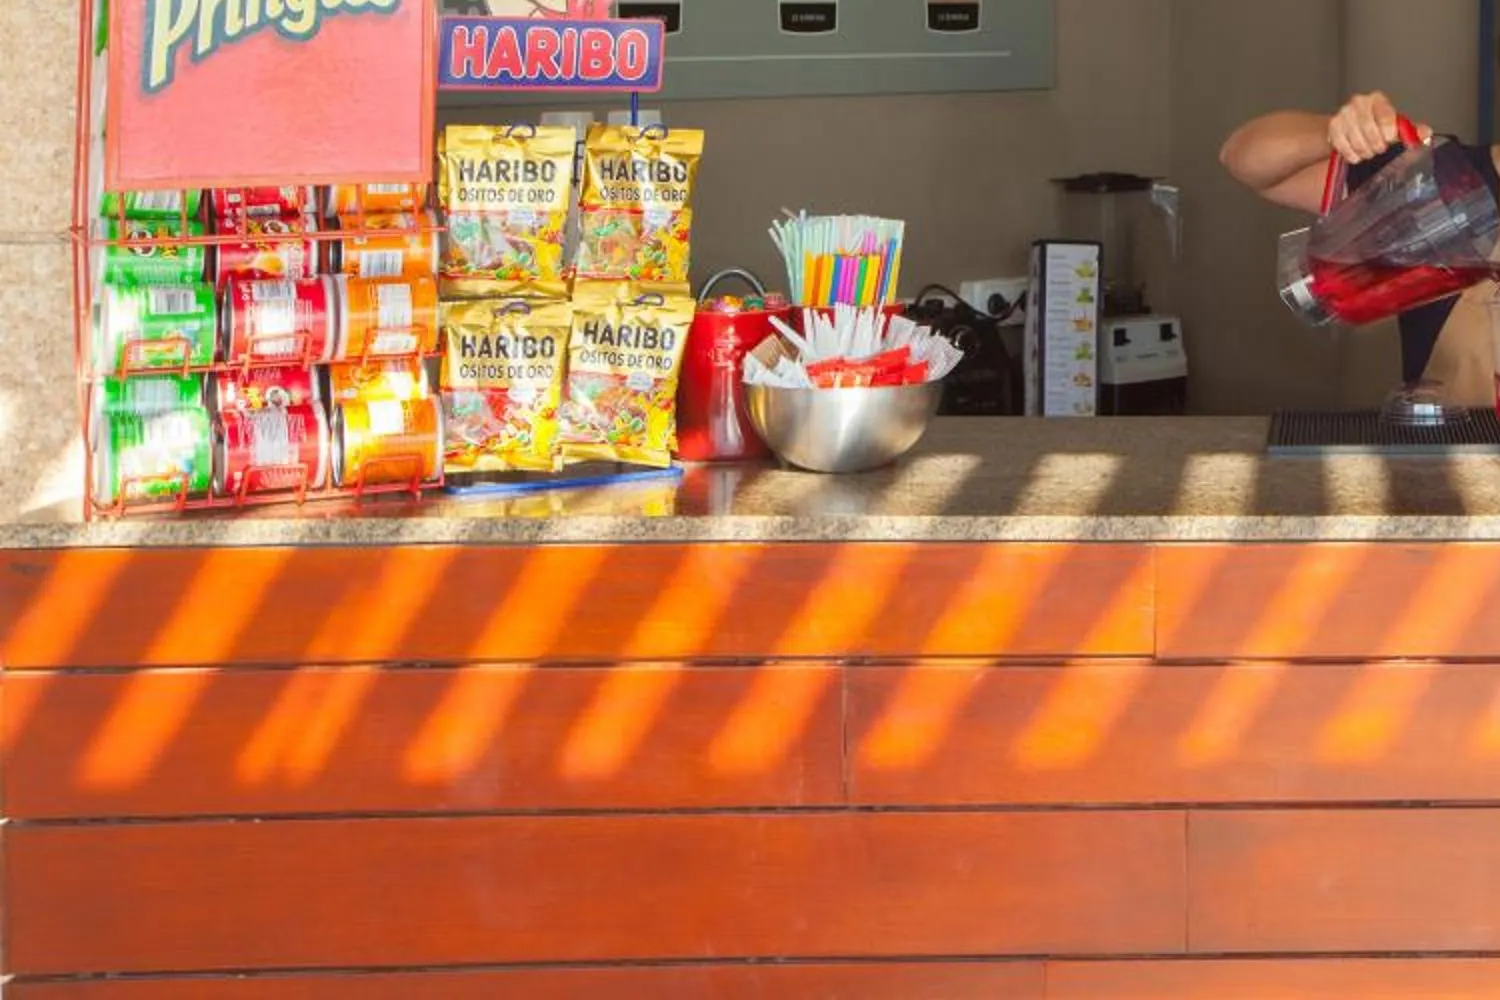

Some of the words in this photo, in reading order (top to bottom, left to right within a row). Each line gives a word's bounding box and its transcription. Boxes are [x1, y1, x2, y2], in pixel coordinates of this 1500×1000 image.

[451, 25, 649, 81] HARIBO
[459, 159, 556, 183] HARIBO
[601, 159, 688, 184] HARIBO
[458, 187, 505, 202] OSITOS
[507, 188, 524, 203] DE
[527, 189, 556, 203] ORO
[460, 335, 555, 359] HARIBO
[583, 320, 676, 351] HARIBO
[459, 363, 504, 379] OSITOS
[507, 364, 524, 379] DE
[526, 365, 555, 380] ORO
[579, 350, 625, 367] OSITOS
[627, 354, 643, 368] DE
[645, 355, 673, 370] ORO
